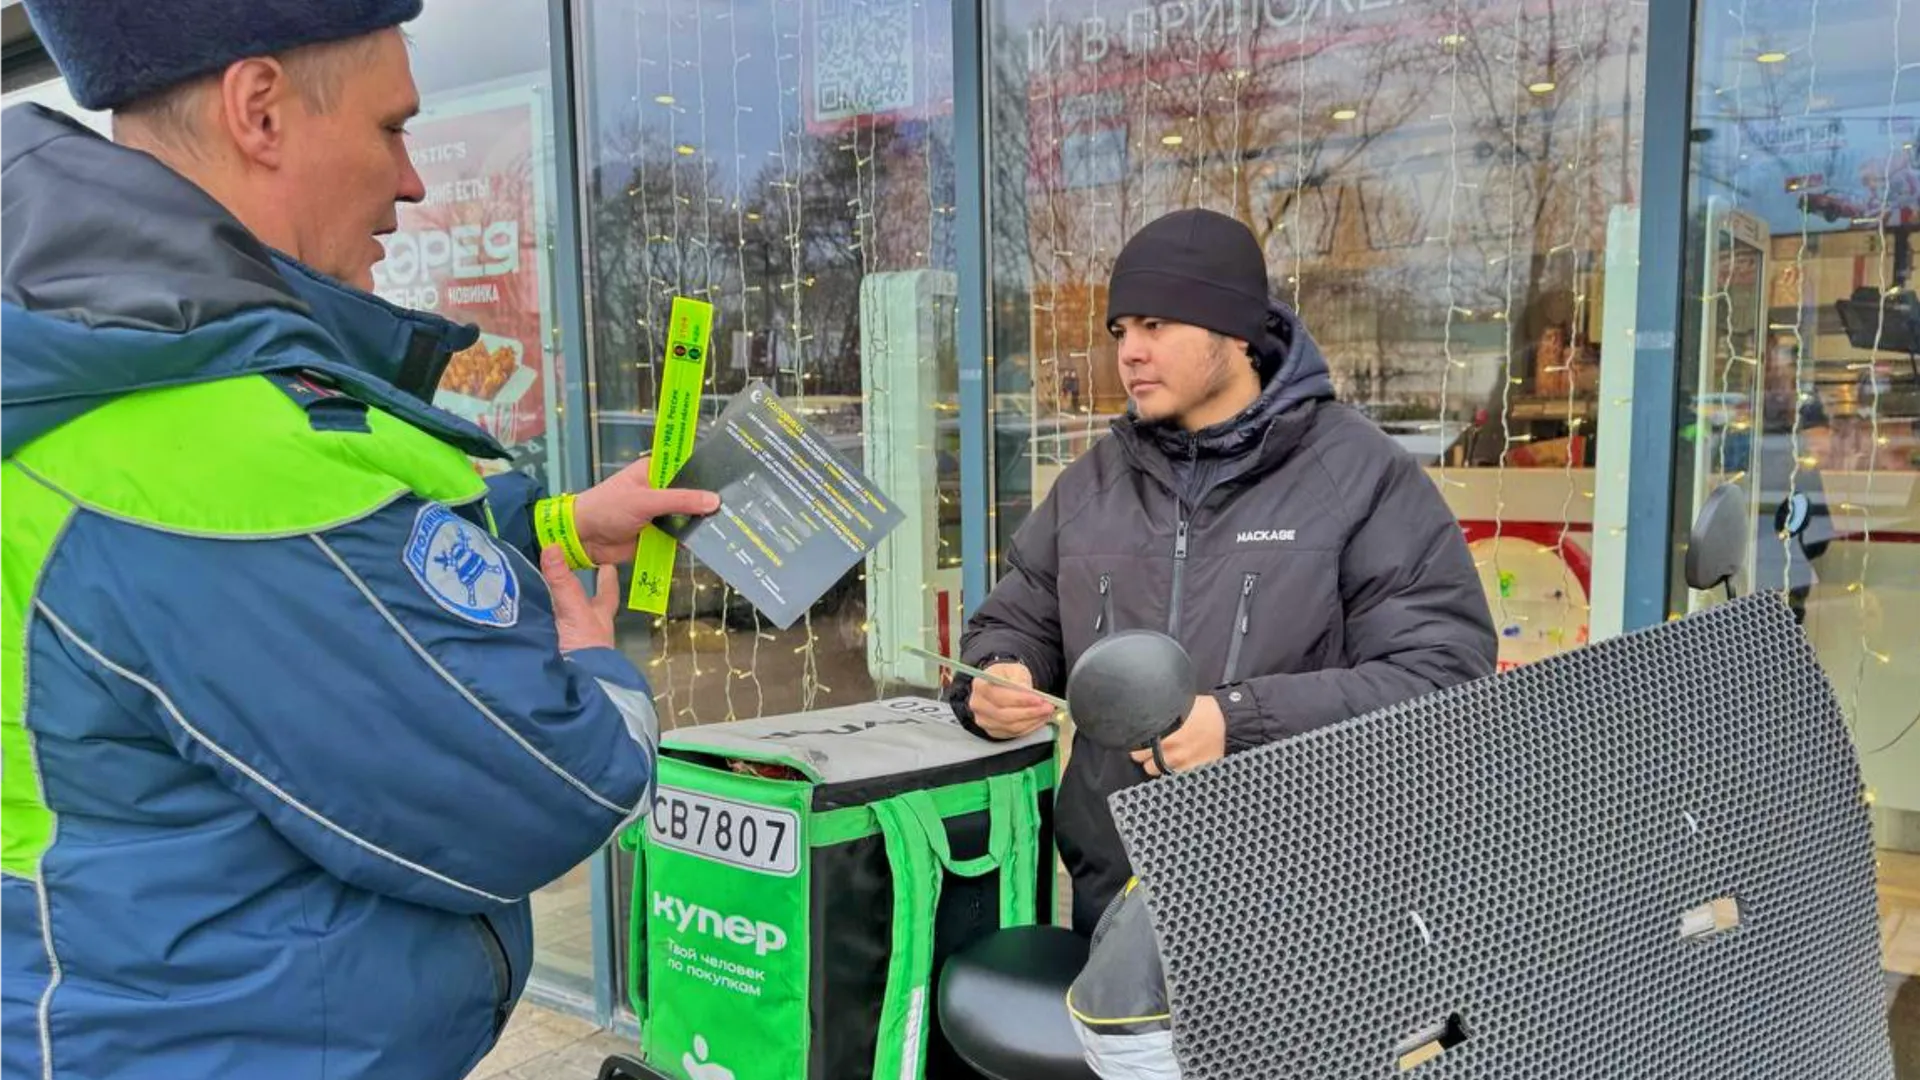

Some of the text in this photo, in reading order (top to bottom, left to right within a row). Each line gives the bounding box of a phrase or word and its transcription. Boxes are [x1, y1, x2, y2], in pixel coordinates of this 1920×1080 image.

[1082, 18, 1107, 62] В
[1127, 0, 1393, 54] ПРИЛО
[449, 284, 499, 304] НОВИНКА
[1236, 529, 1296, 543] MACKAGE
[653, 891, 787, 956] купер
[667, 937, 765, 982] Твой человек
[668, 958, 761, 996] по покупкам
